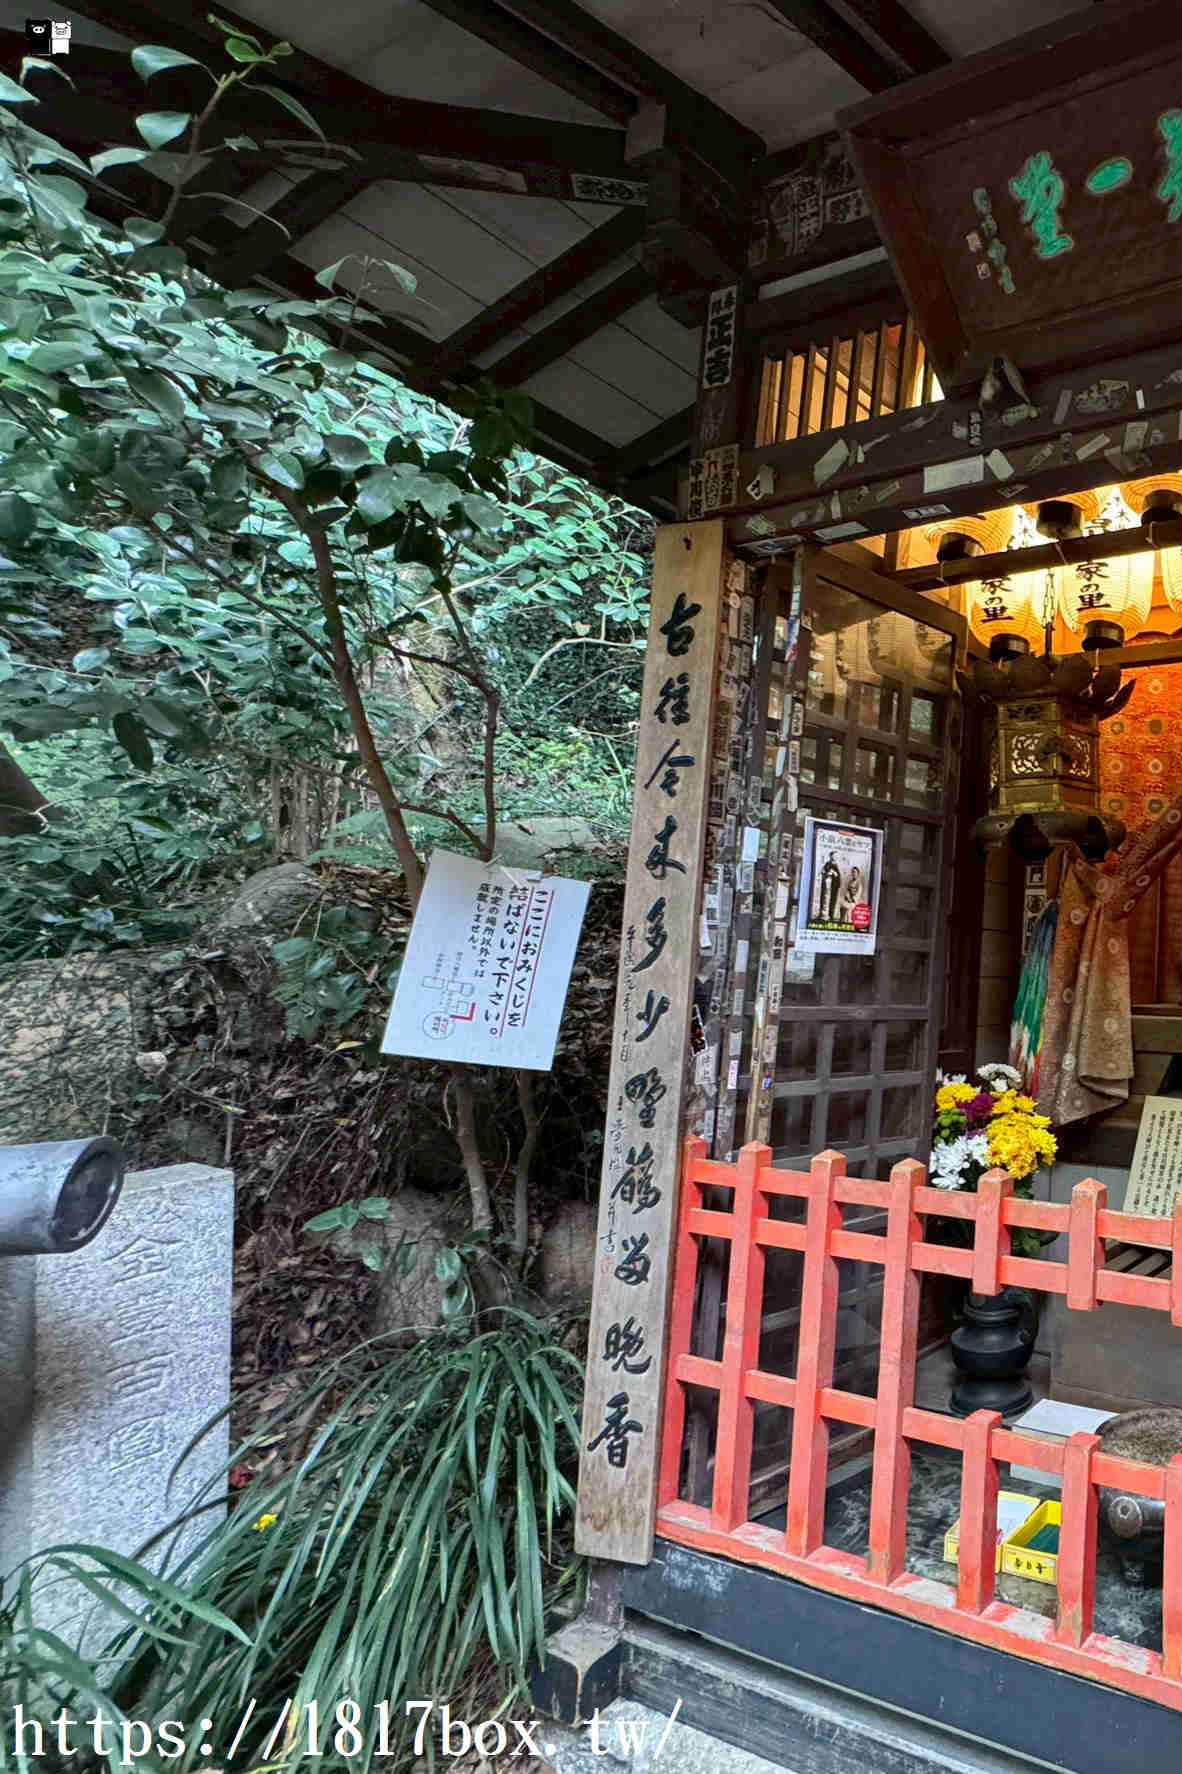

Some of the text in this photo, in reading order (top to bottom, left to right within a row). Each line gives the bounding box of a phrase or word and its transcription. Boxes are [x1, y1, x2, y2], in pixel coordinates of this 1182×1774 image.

[474, 885, 505, 978] 所定の場所以外では
[484, 886, 529, 1035] 結ばないで下さい。
[508, 890, 551, 1027] ここにおみくじを
